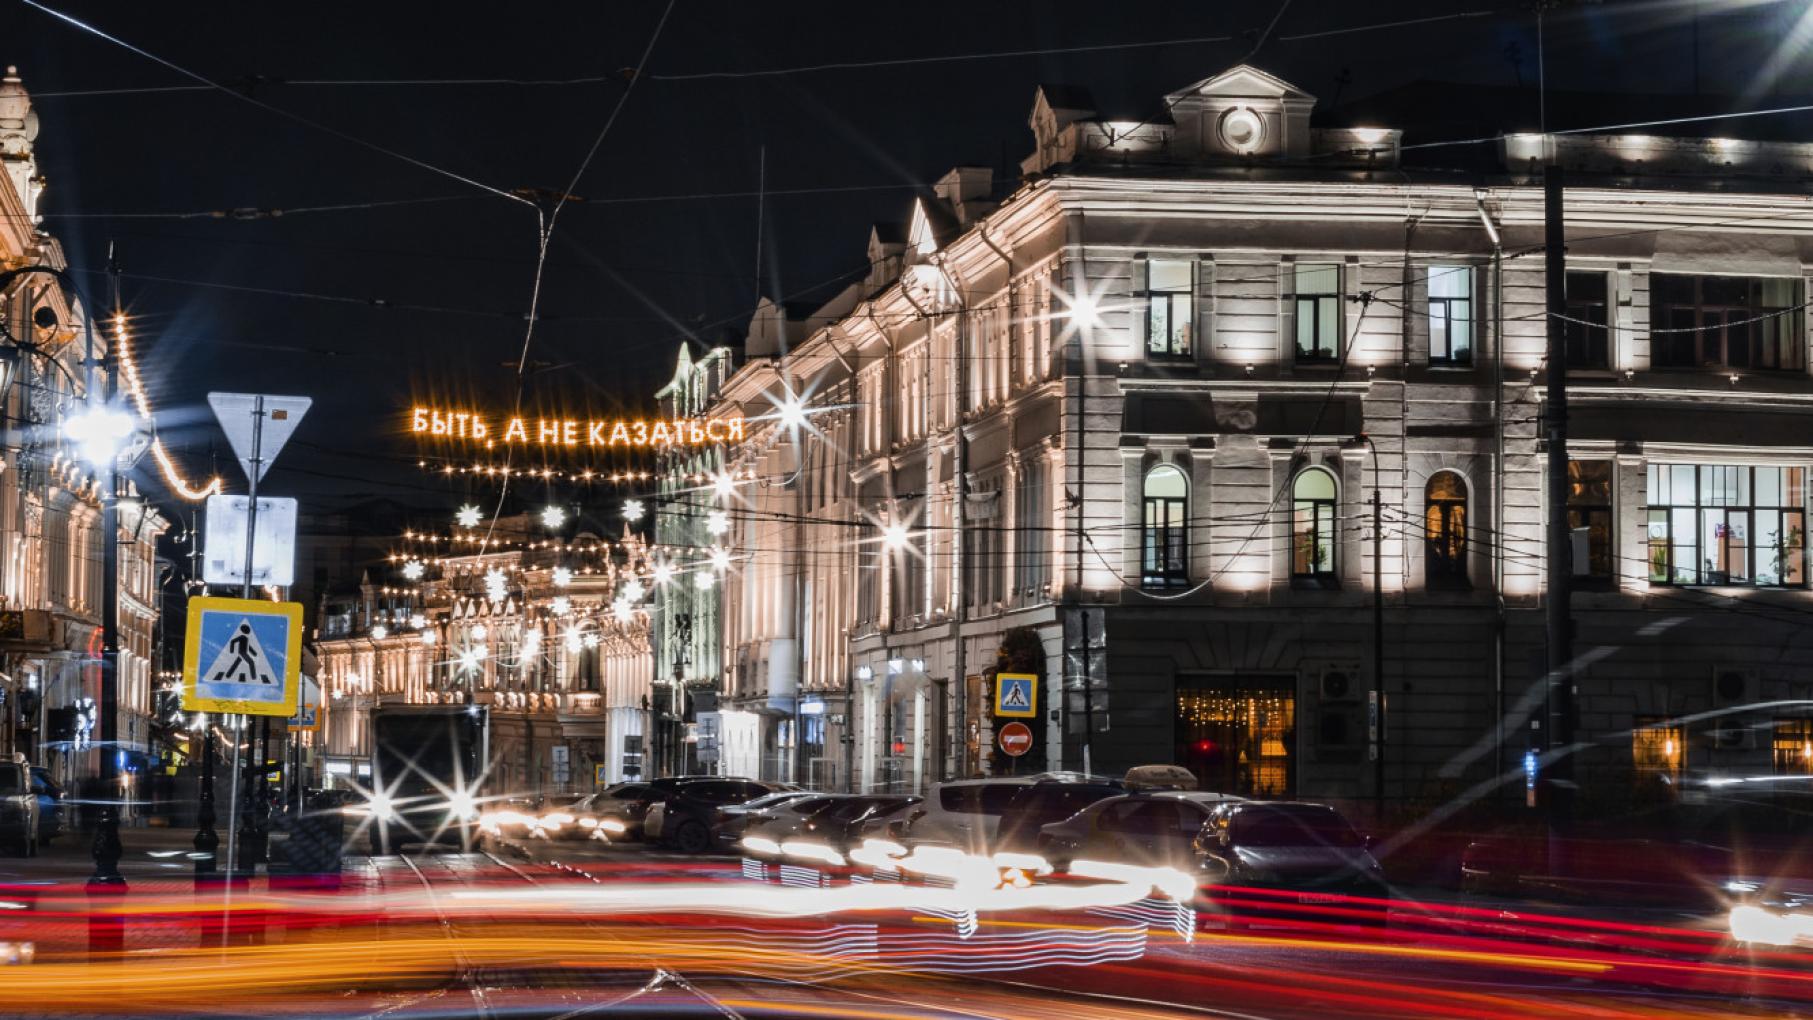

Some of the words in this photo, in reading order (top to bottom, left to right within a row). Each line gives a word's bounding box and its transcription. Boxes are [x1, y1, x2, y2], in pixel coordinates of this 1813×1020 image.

[412, 408, 493, 449] БЫТЬ,
[505, 418, 527, 442] А
[539, 420, 577, 445] НЕ
[589, 417, 744, 446] КАЗАТЬСЯ
